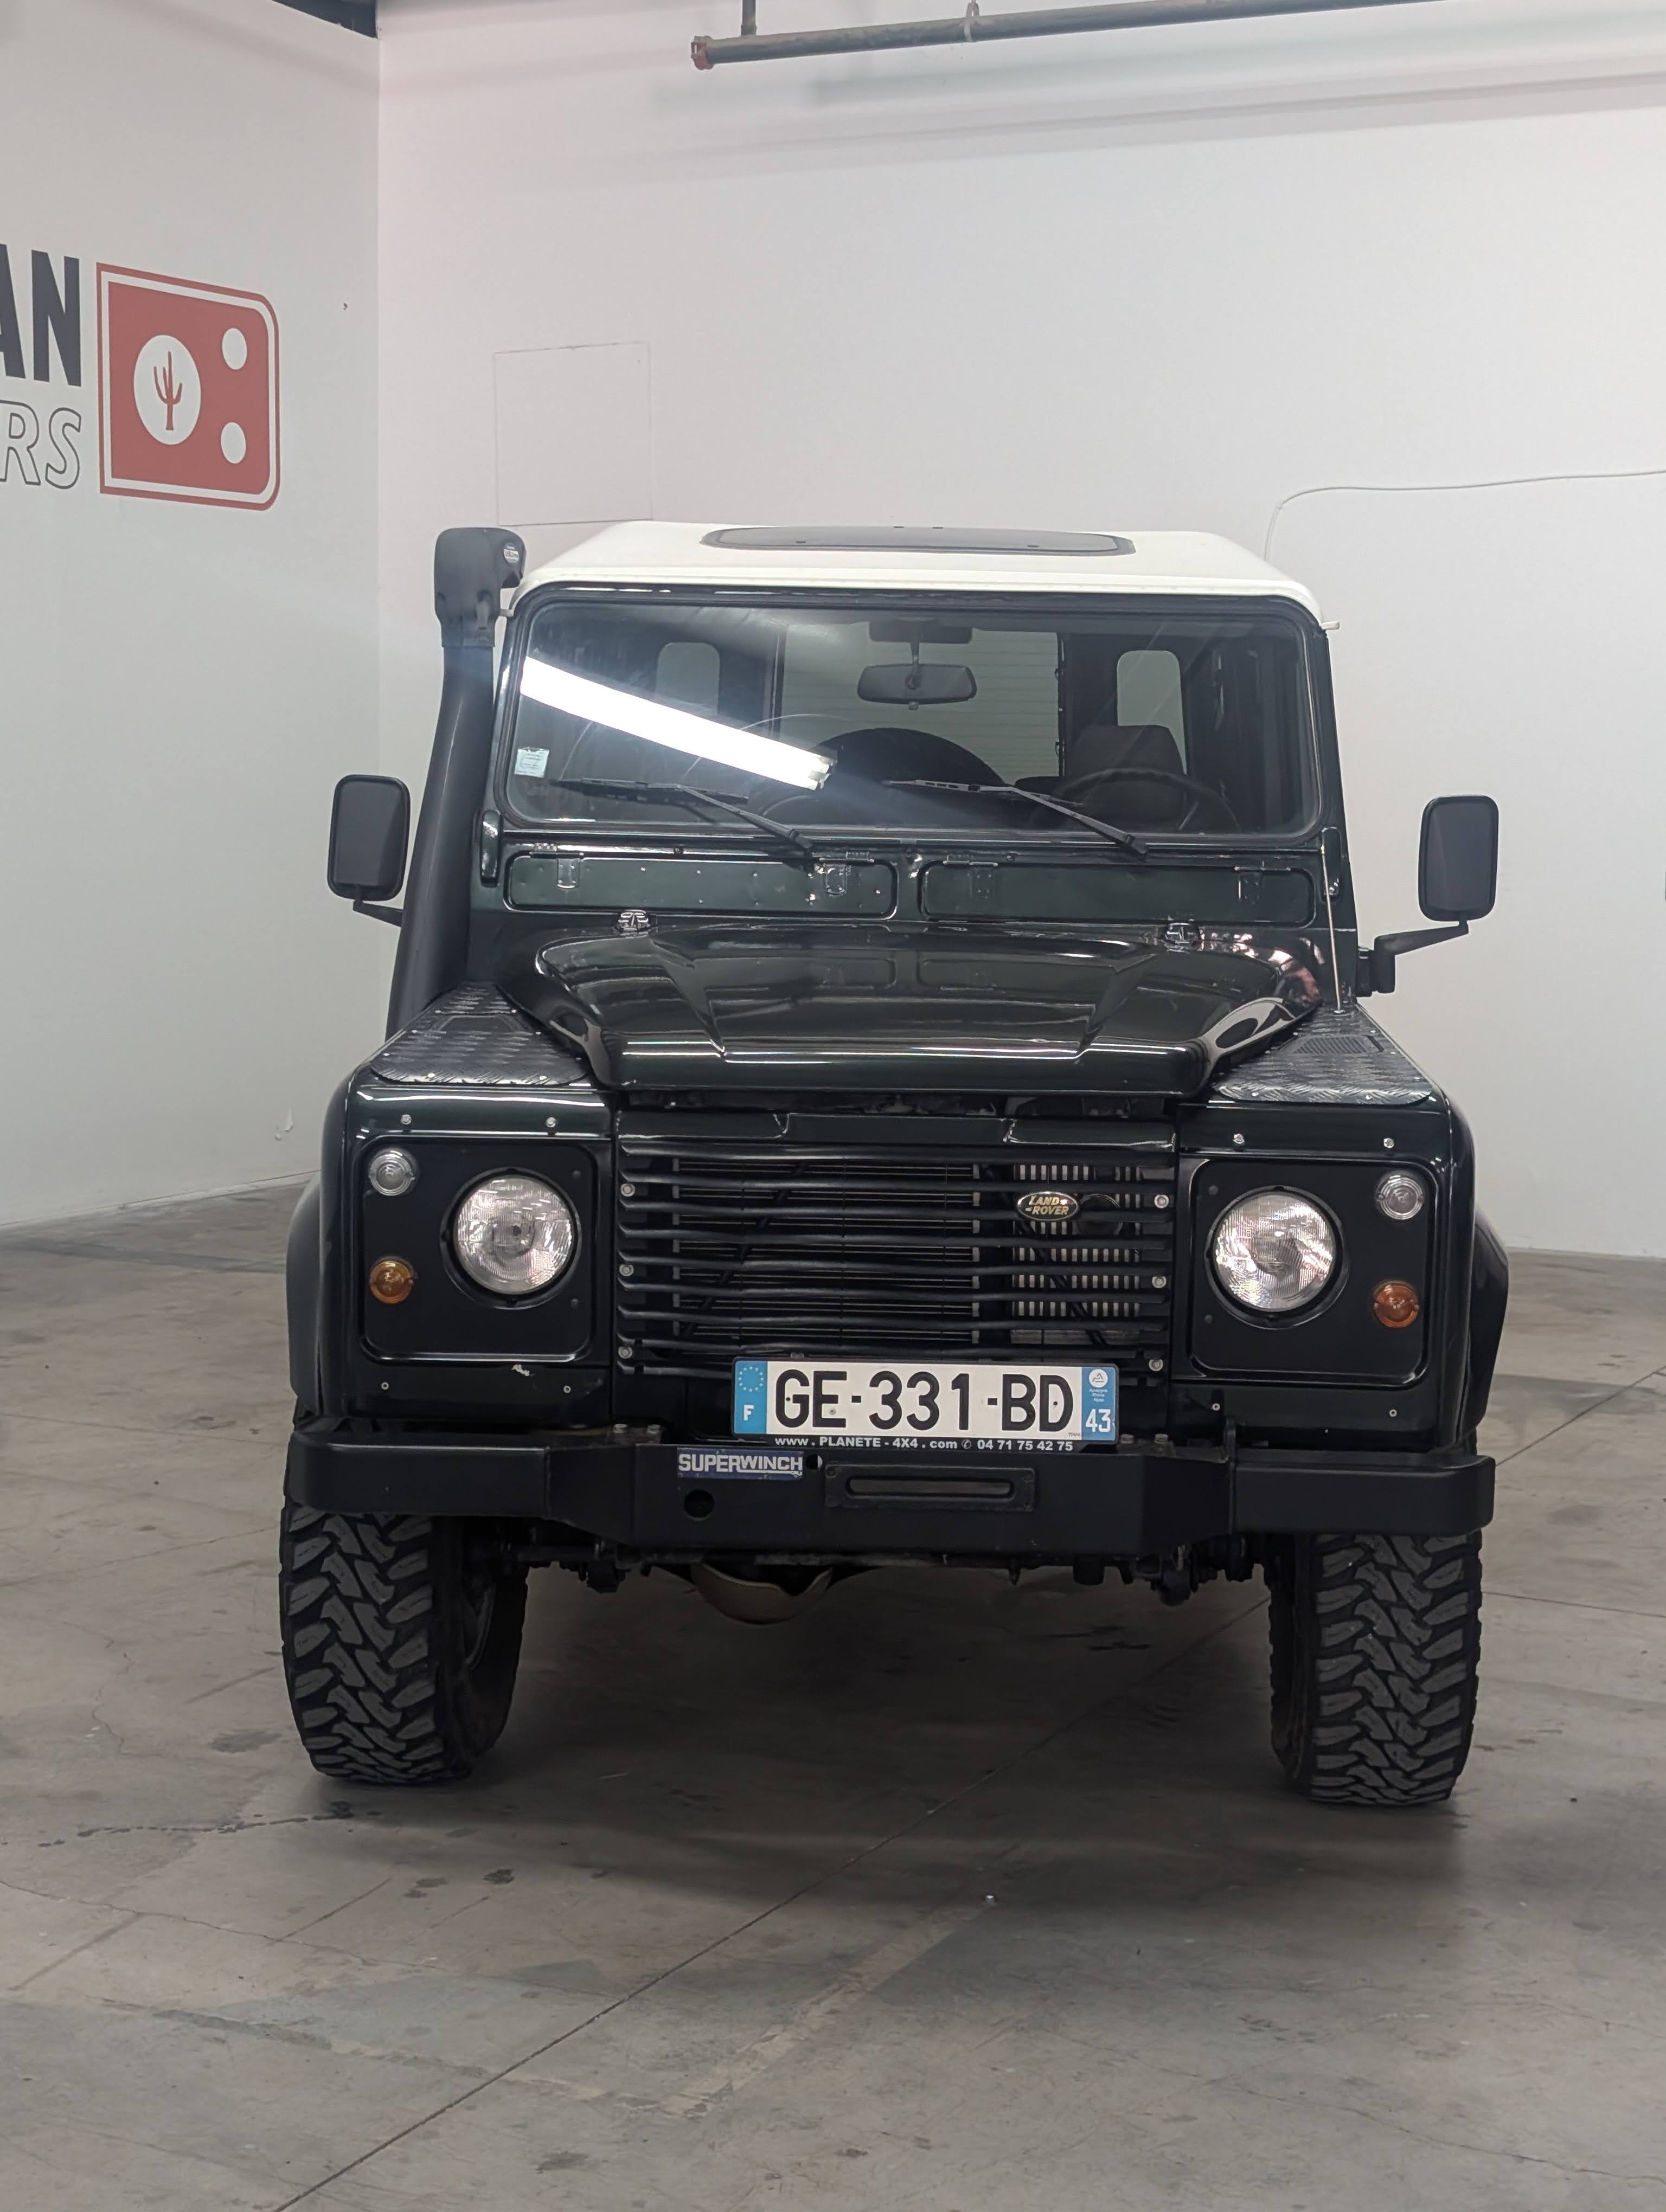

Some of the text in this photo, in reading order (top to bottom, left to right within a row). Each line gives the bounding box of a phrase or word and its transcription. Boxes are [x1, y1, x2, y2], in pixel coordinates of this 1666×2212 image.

[1029, 1195, 1060, 1205] LAND
[1032, 1206, 1069, 1215] ROVER
[776, 1369, 1074, 1432] GE-331-BD
[743, 1404, 754, 1421] F
[1085, 1408, 1111, 1432] 43
[977, 1439, 994, 1450] 04
[997, 1440, 1013, 1450] 71
[1017, 1440, 1034, 1451] 75
[1036, 1441, 1053, 1451] 42
[1056, 1441, 1073, 1451] 75
[678, 1454, 803, 1472] SUPERWINCH
